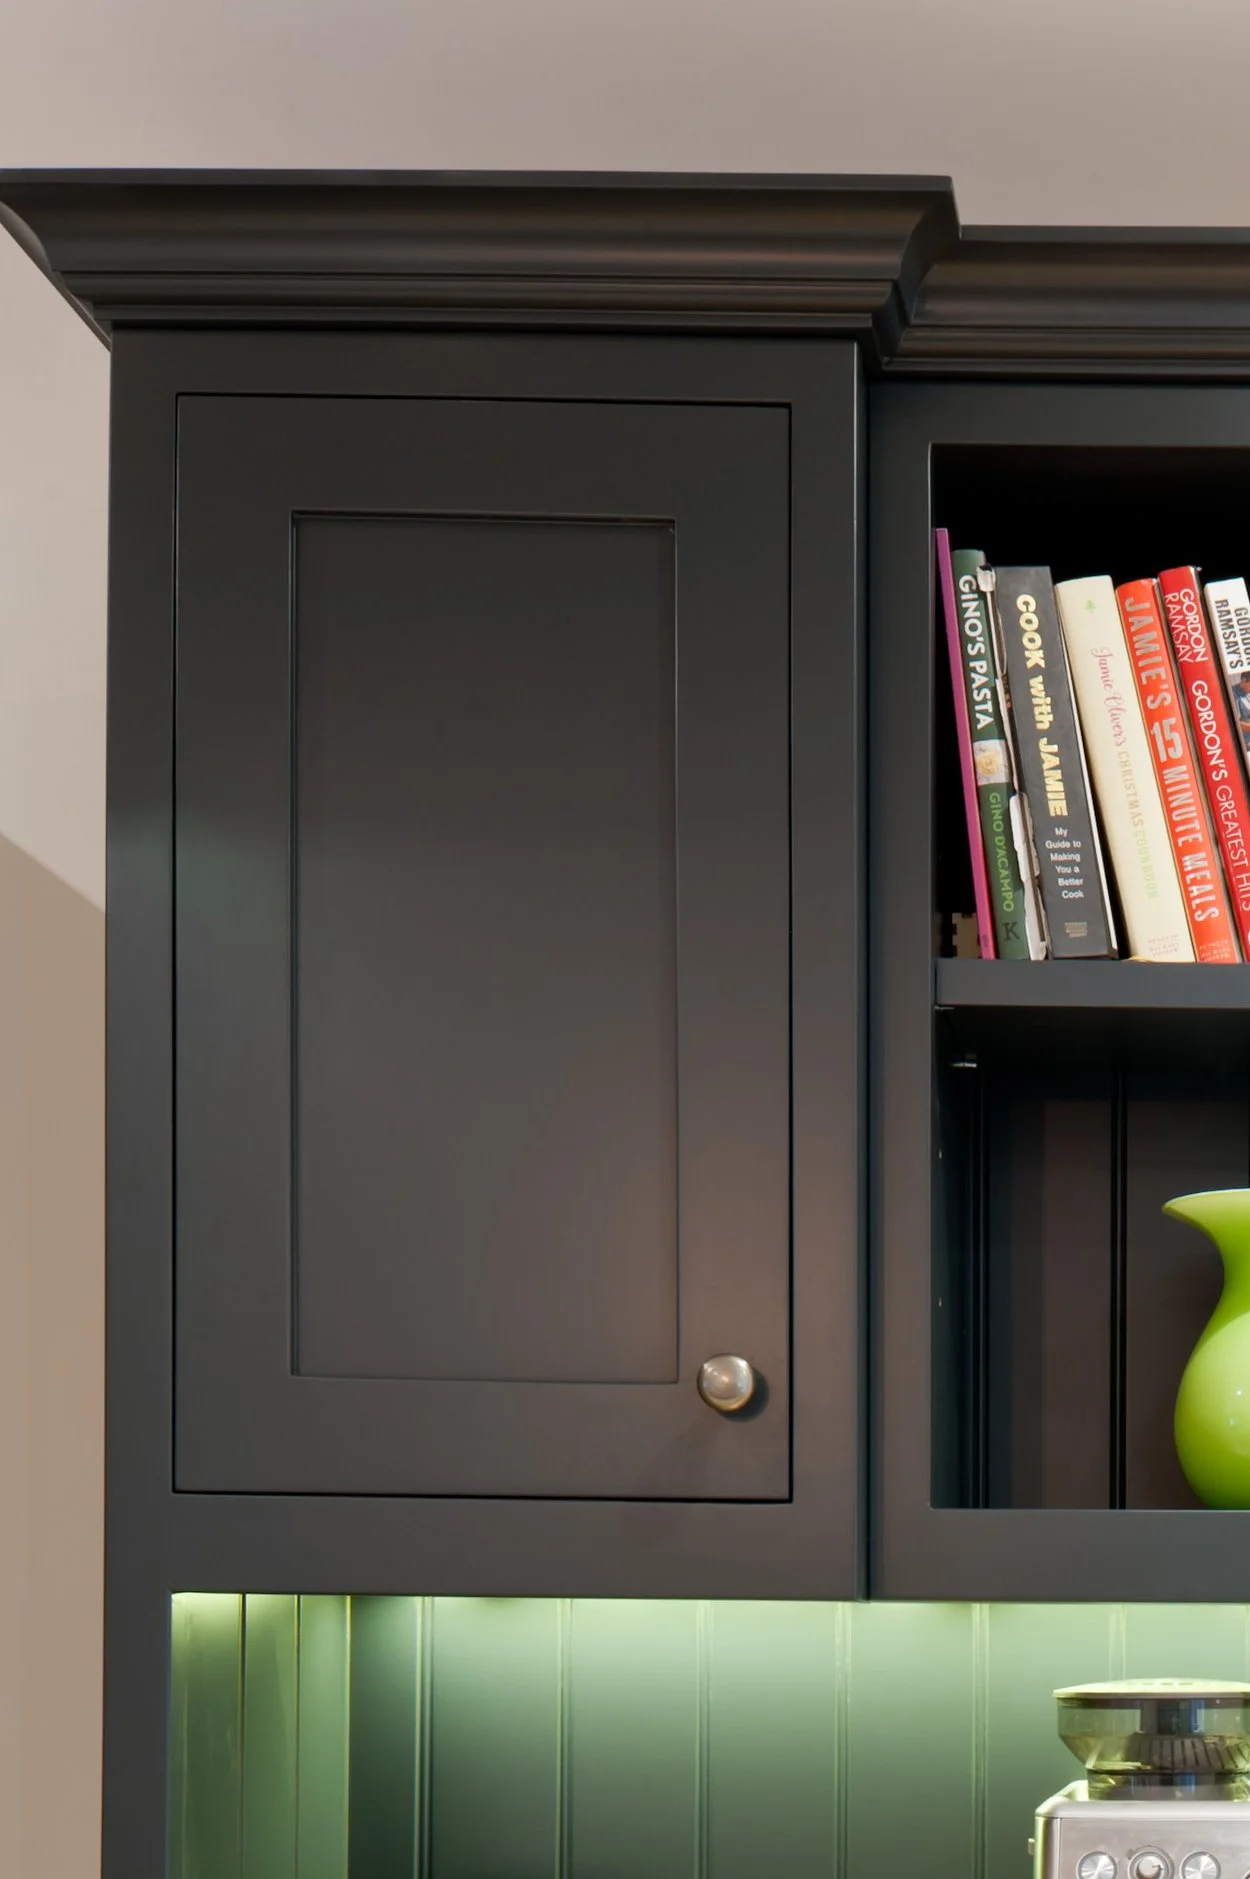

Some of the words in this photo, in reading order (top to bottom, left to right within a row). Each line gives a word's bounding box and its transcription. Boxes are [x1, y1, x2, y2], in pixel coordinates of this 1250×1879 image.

[958, 574, 985, 656] GINO'S
[1016, 594, 1045, 670] COOK
[1164, 591, 1194, 664] RAMSAY
[1180, 588, 1209, 663] GORDON
[1214, 599, 1244, 669] RAMSAY'S
[1125, 597, 1172, 710] JAMIE'S
[970, 660, 994, 730] PASTA
[1029, 675, 1054, 730] with
[1091, 647, 1113, 692] Jamie
[1104, 694, 1128, 748] Oliver's
[1117, 751, 1143, 828] CHRISTMAS
[1134, 829, 1159, 899] COOKBOOK
[1151, 717, 1183, 763] 15
[1192, 680, 1229, 782] GORDON'S
[1216, 785, 1249, 867] GREATEST
[989, 792, 1004, 832] GINO
[1038, 737, 1069, 817] JAMIE
[1162, 765, 1203, 847] MINUTE
[1045, 840, 1071, 849] Guide
[1073, 839, 1081, 848] to
[1050, 852, 1081, 862] Making
[1055, 827, 1068, 837] My
[995, 837, 1015, 912] D'ACAMPO
[1055, 865, 1071, 874] You
[1058, 877, 1084, 887] Better
[1061, 889, 1084, 899] Cook
[1182, 851, 1220, 923] MEALS
